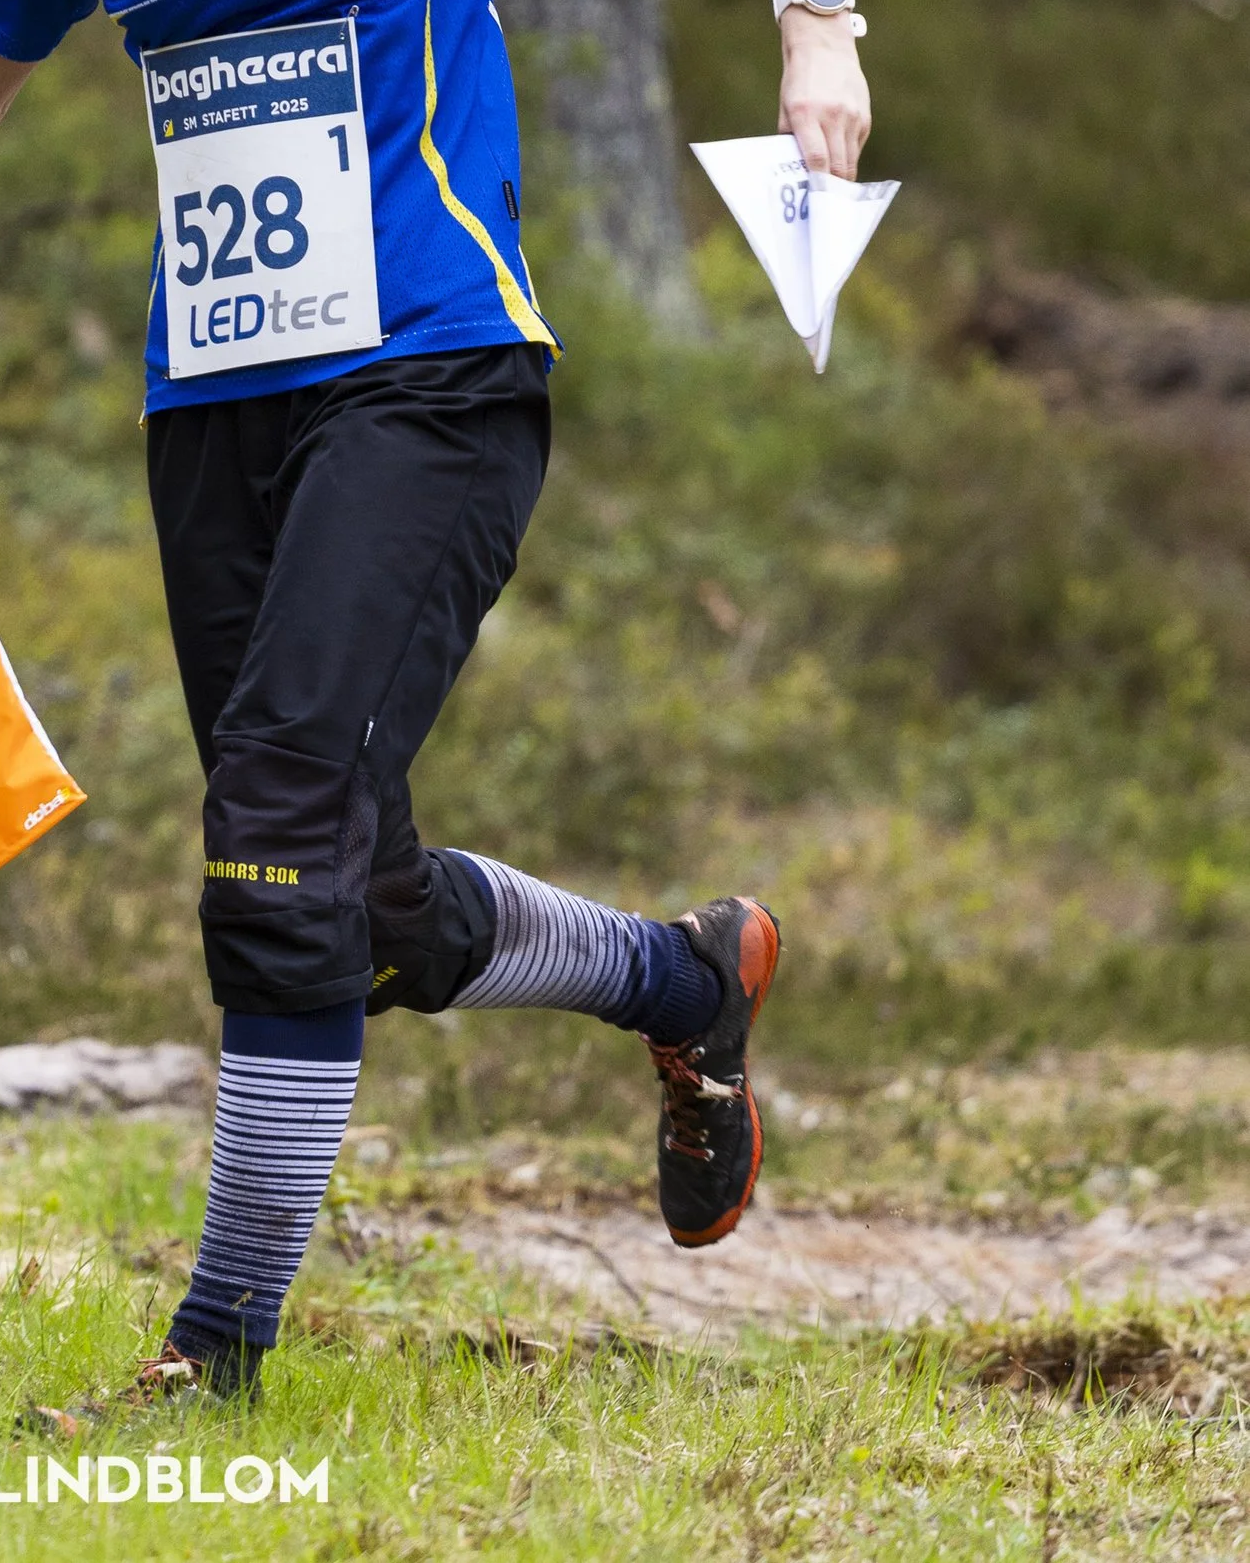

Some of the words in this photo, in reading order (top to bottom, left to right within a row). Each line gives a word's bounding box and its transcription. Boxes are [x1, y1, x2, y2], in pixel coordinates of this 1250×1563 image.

[151, 43, 348, 103] bagheera
[183, 116, 197, 131] SM
[202, 105, 257, 126] STAFETT
[270, 98, 309, 115] 2025
[327, 124, 350, 172] 1
[174, 176, 309, 286] 528
[190, 289, 348, 348] LEDtec
[265, 866, 299, 885] SOK
